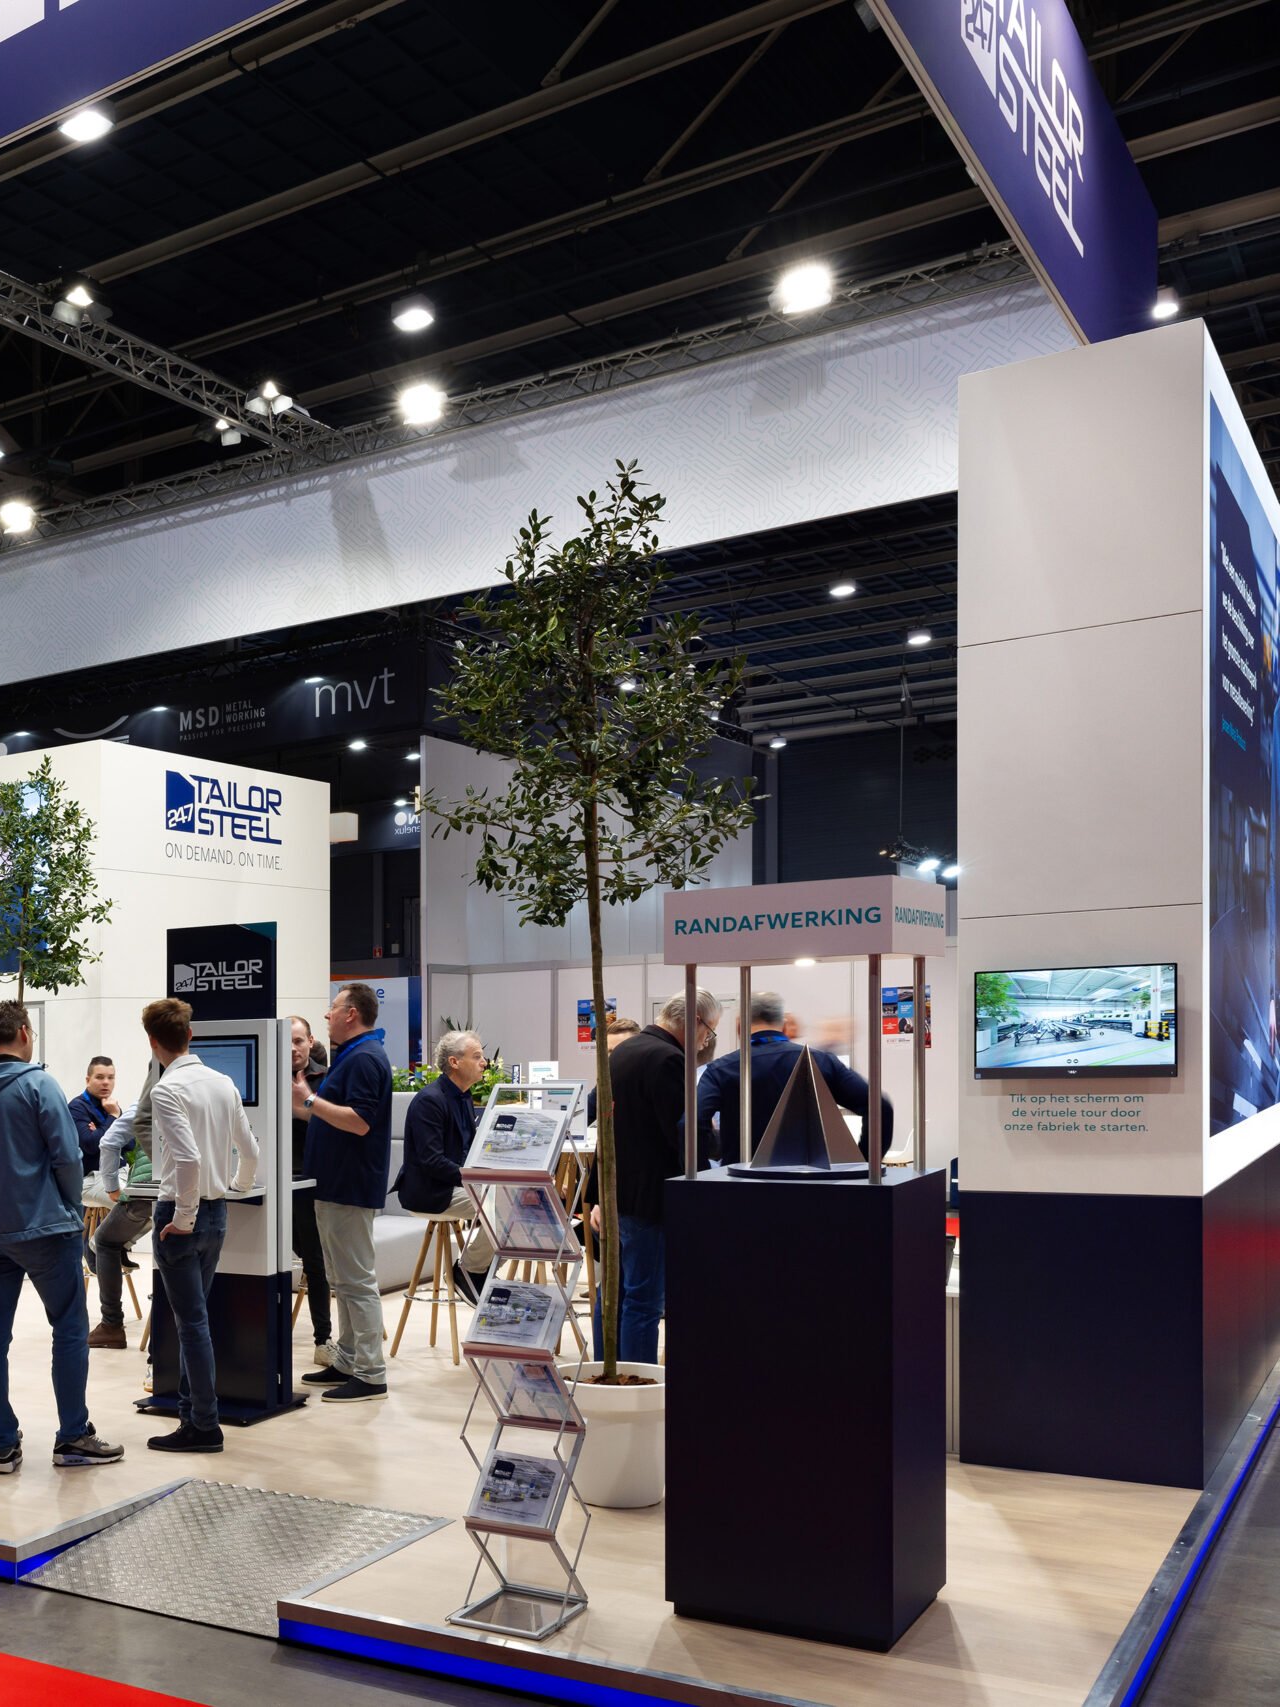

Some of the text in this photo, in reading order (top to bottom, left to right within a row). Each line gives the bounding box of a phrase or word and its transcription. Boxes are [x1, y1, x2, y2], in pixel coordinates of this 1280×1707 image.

[999, 0, 1084, 183] AILOR
[999, 34, 1084, 258] STEEL
[315, 667, 395, 718] mvt
[225, 699, 253, 713] METAL
[225, 707, 265, 723] WORKING
[179, 706, 219, 731] MSD
[179, 731, 207, 742] PASSION
[189, 774, 282, 816] TAILOR
[167, 803, 194, 828] 247
[198, 807, 282, 845] STEEL
[165, 842, 283, 871] ON DEMAND. ON TIME.
[674, 906, 882, 935] RANDAFWERKING
[895, 905, 945, 929] RANDAFWERKING
[191, 959, 263, 977] TAILOR
[175, 977, 193, 991] 247
[196, 975, 263, 992] STEEL
[1009, 1093, 1027, 1103] Tik
[1030, 1095, 1046, 1105] op
[1050, 1093, 1070, 1103] het
[1074, 1093, 1120, 1103] scherm
[1012, 1107, 1141, 1117] de virtuele tour door
[1004, 1121, 1149, 1132] onze fabriek te starten.
